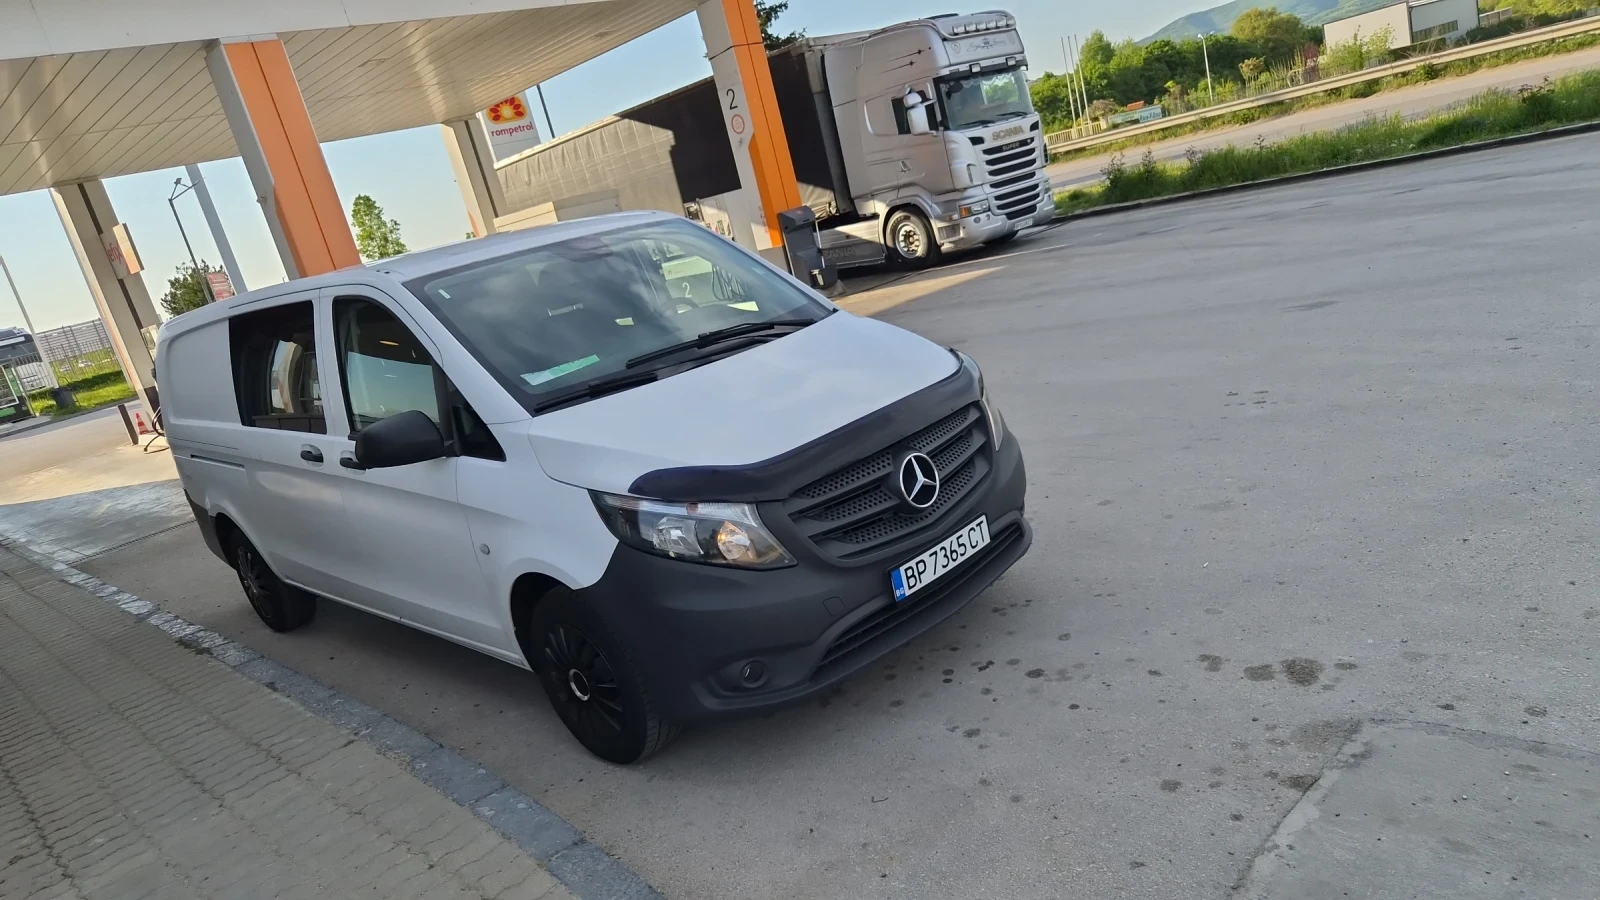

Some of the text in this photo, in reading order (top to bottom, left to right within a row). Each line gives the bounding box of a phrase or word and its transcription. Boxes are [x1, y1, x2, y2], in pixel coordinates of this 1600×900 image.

[726, 88, 738, 110] 2
[490, 121, 534, 137] rompetrol
[991, 125, 1025, 141] SCANIA
[1002, 141, 1020, 152] SUPER
[682, 282, 692, 298] 2
[904, 520, 986, 591] BP 7365 CT
[895, 587, 904, 597] BG
